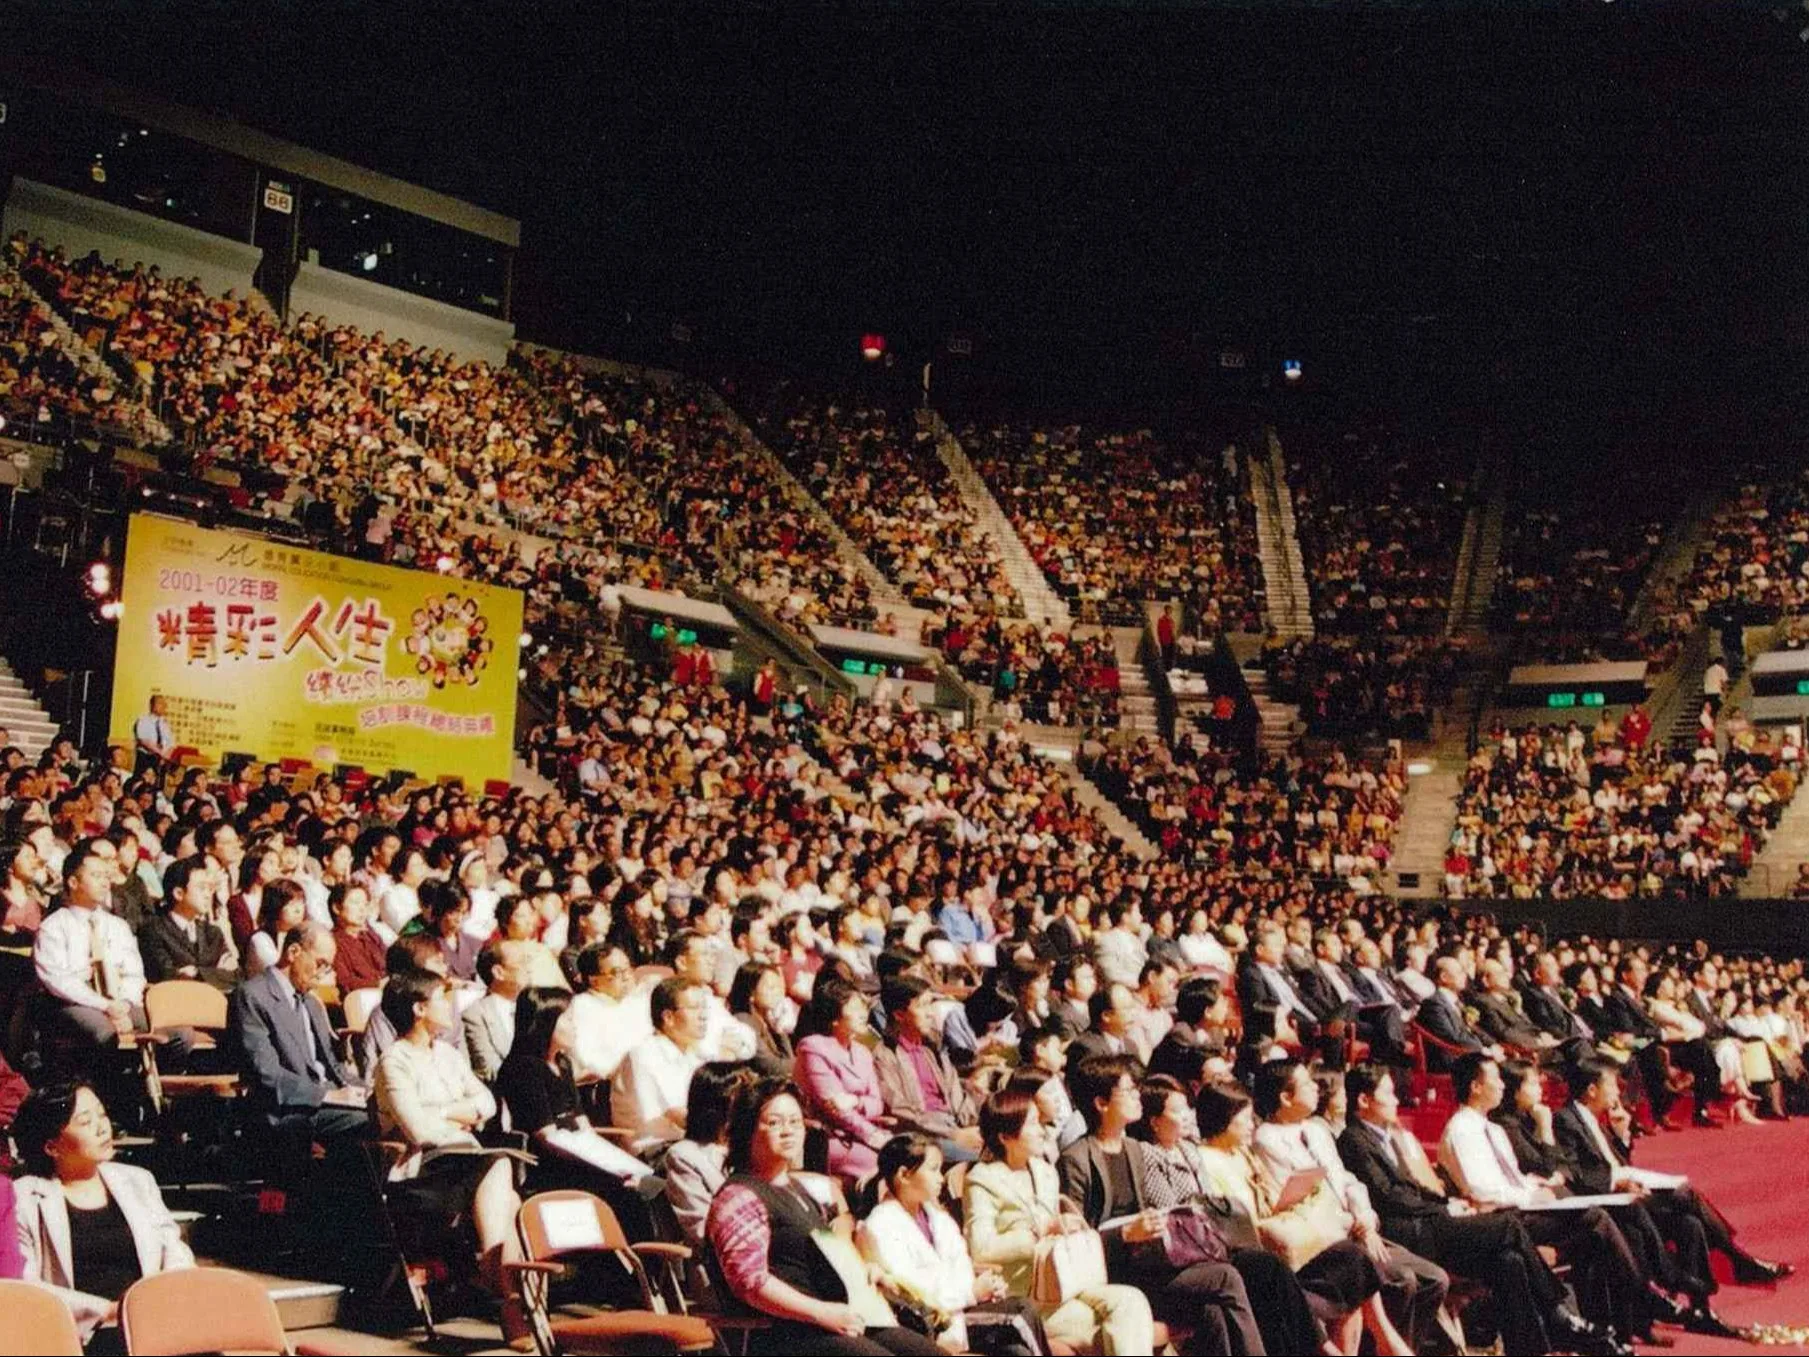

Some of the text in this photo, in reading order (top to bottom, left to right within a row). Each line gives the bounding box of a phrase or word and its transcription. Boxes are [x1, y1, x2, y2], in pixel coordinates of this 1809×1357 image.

[159, 567, 278, 601] 2001-02年度
[156, 599, 389, 668] 精彩人生
